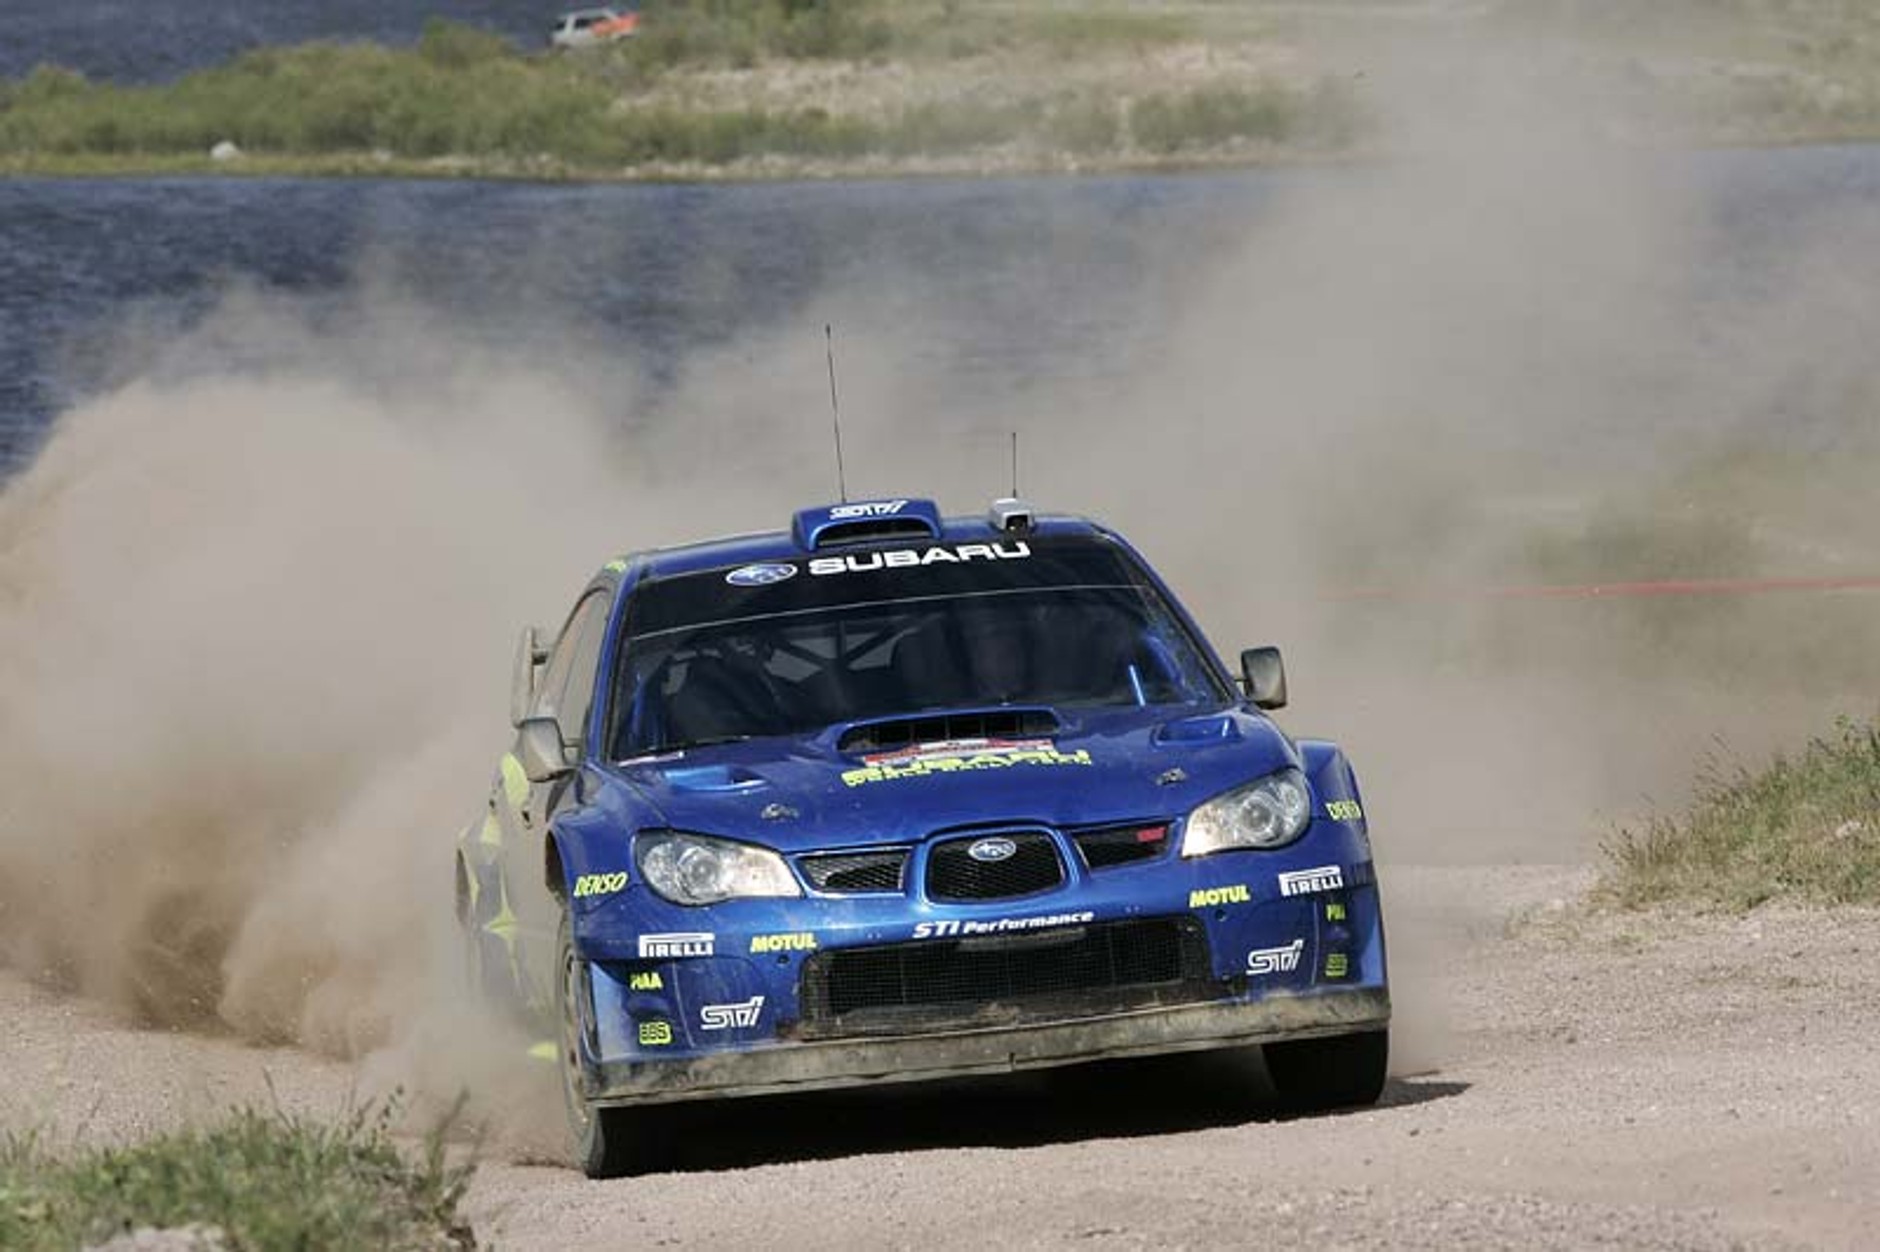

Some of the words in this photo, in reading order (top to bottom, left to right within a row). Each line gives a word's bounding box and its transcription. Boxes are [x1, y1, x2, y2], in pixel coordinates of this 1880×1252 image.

[809, 542, 1031, 575] SUBARU
[573, 872, 629, 897] DENSO
[1278, 864, 1344, 897] PIRELLI
[1189, 884, 1251, 908] MOTUL
[912, 920, 961, 939] STI
[963, 911, 1095, 935] Performance
[638, 931, 716, 958] PIRELLI
[750, 932, 818, 953] MOTUL
